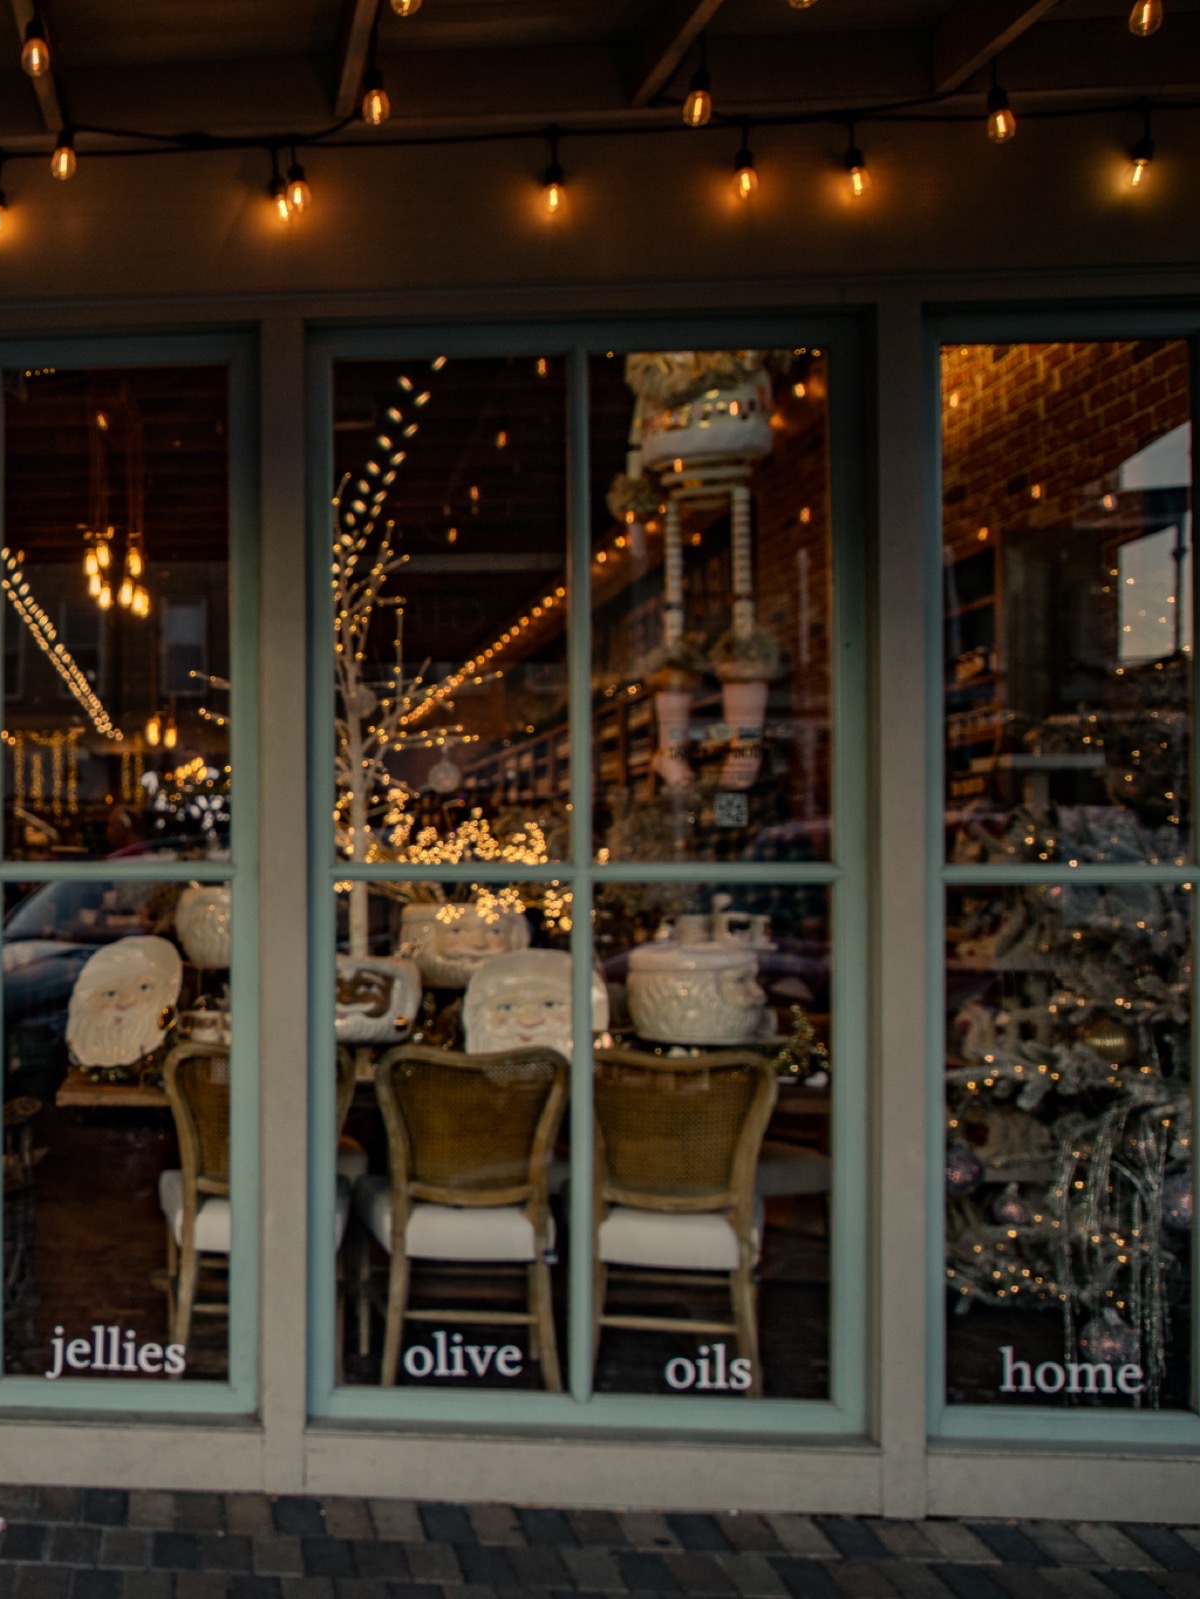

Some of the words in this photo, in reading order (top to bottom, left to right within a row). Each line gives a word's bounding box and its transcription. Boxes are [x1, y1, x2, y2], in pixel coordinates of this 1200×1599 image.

[46, 1325, 186, 1379] jellies
[403, 1330, 524, 1377] olive
[665, 1343, 753, 1389] oils
[1000, 1340, 1145, 1393] home
